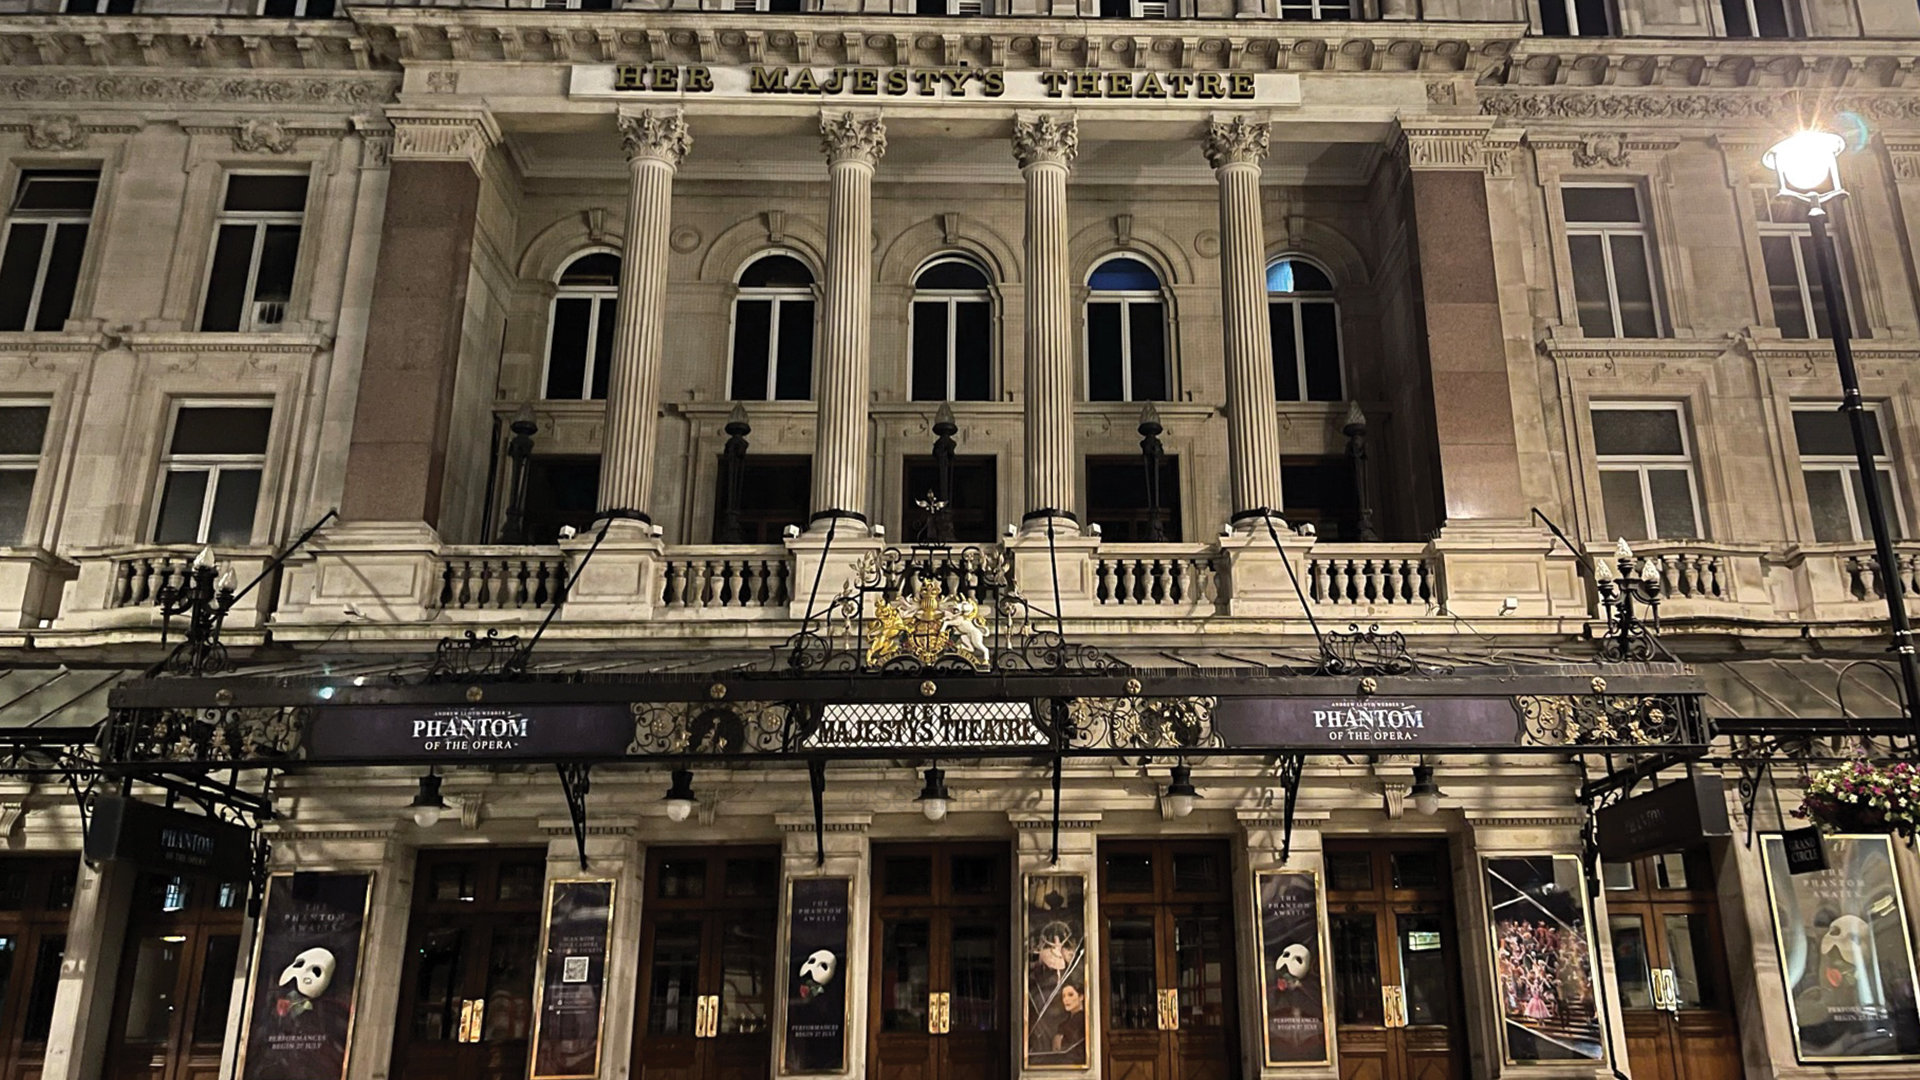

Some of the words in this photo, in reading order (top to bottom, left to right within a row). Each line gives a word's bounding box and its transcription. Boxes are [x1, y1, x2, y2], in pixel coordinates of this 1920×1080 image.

[614, 64, 713, 96] HER
[750, 67, 1005, 97] MAJESTY'S
[1042, 71, 1255, 99] THEATRE
[903, 704, 951, 721] HER
[1313, 709, 1424, 729] PHANTOM
[412, 718, 528, 738] PHANTOM
[941, 719, 1037, 742] THEATRE
[1329, 732, 1343, 741] OF
[1348, 732, 1370, 741] THE
[1374, 732, 1412, 741] OPERA
[424, 742, 441, 750] OF
[445, 741, 469, 750] THE
[472, 741, 512, 750] OPERA
[161, 830, 214, 854] PHANTOM
[1791, 848, 1818, 863] CIRCLE
[1803, 879, 1865, 888] PHANTOM
[1812, 890, 1863, 898] AWAITS
[798, 907, 842, 915] PHANTOM
[283, 913, 346, 922] PHANTOM
[802, 915, 837, 923] AWAITS
[268, 1034, 327, 1042] PERFORMANCES
[271, 1043, 295, 1051] BEGIN
[305, 1042, 323, 1050] JULY
